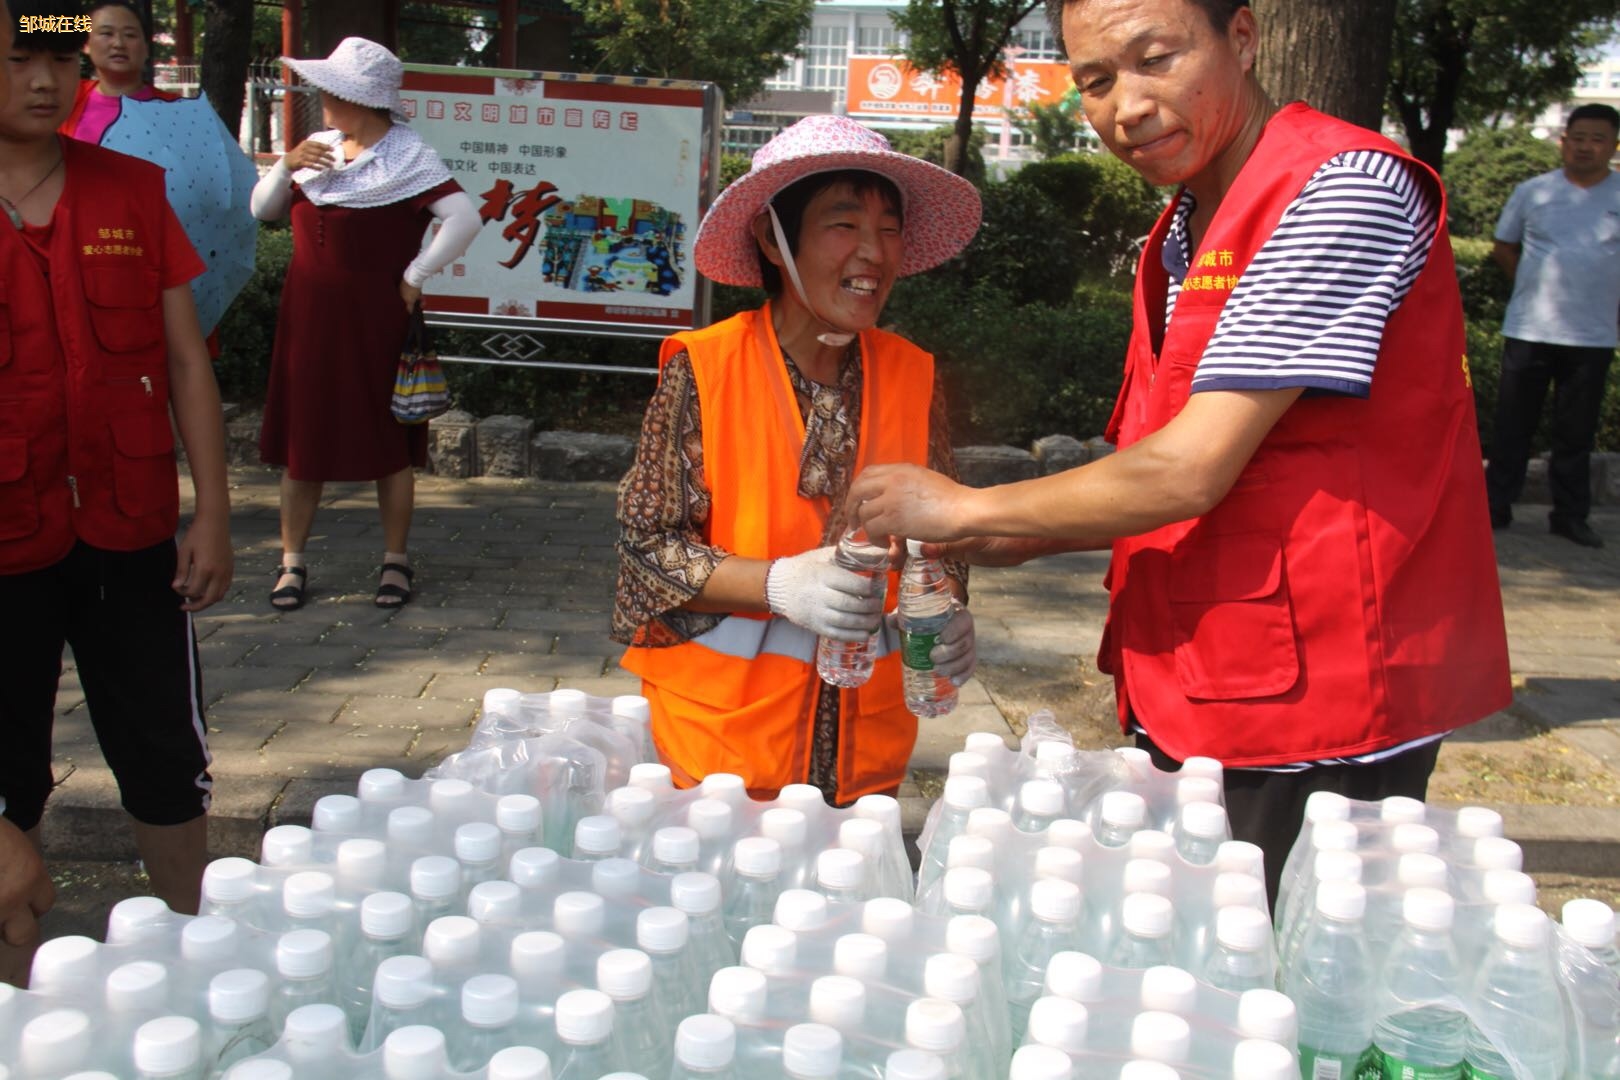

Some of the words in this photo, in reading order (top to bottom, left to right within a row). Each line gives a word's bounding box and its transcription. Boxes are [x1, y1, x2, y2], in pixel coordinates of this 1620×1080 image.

[400, 98, 639, 131] 创建文明城市宣传栏
[459, 140, 509, 155] 中国精神
[518, 144, 567, 158] 中国形象
[488, 161, 537, 176] 中国表达
[1196, 249, 1234, 267] 城市
